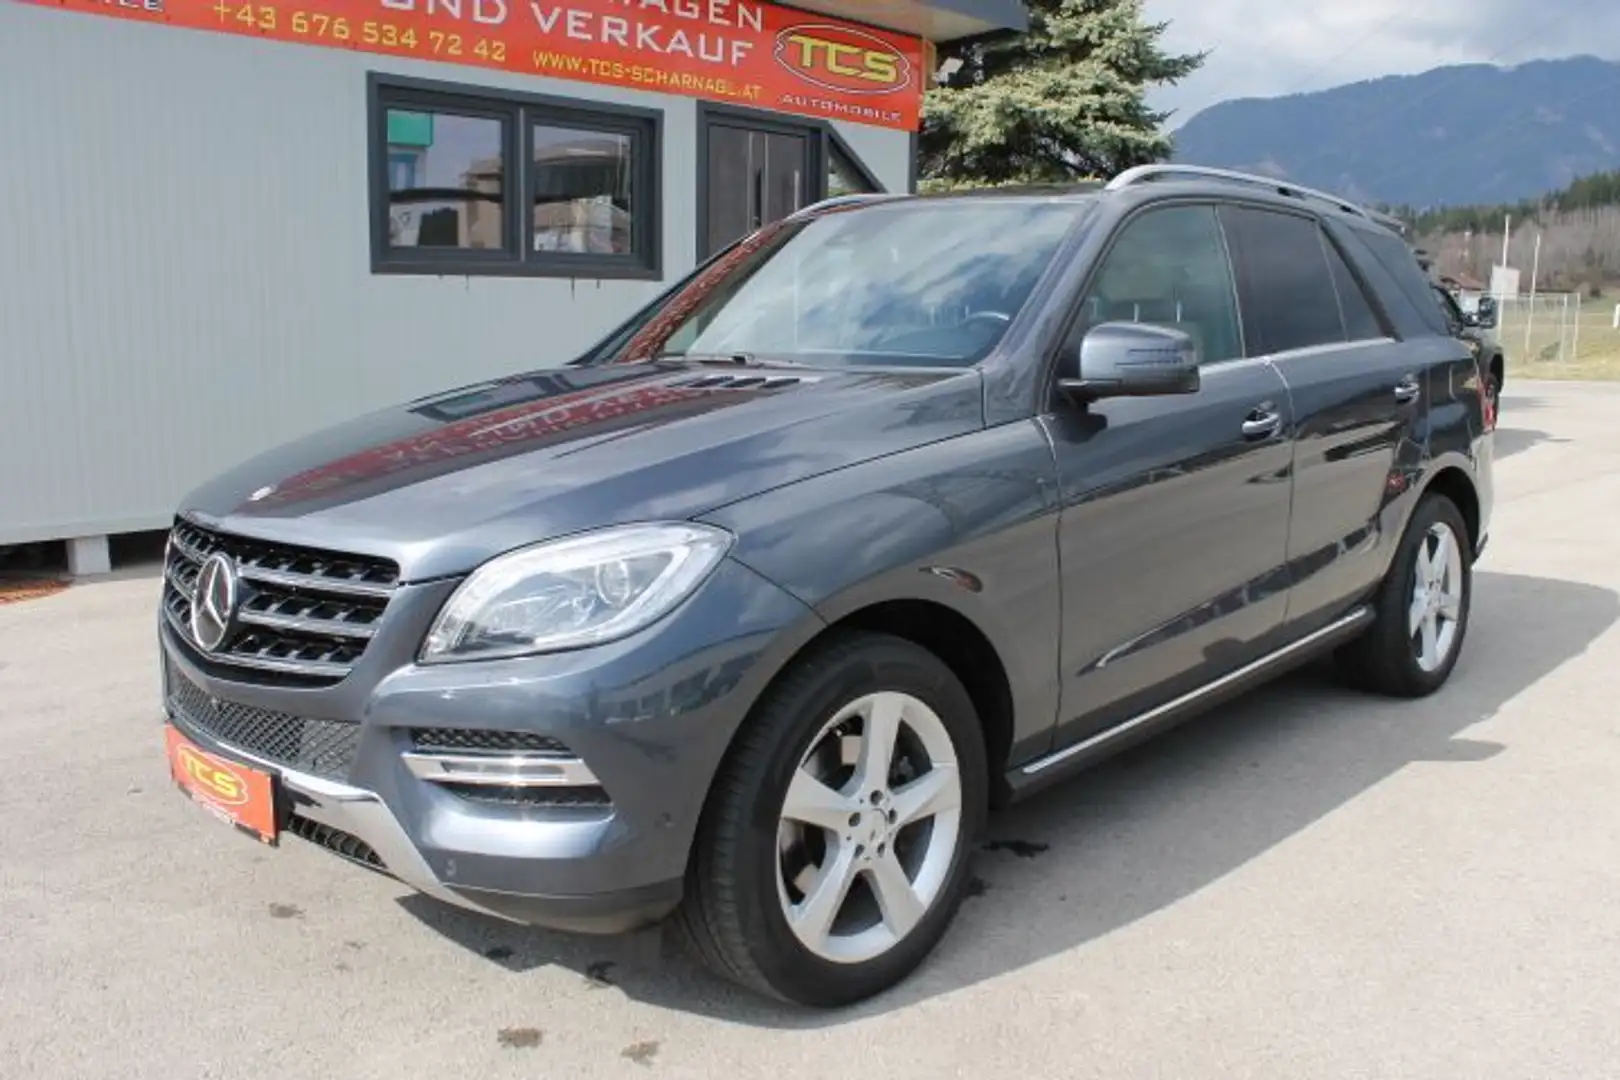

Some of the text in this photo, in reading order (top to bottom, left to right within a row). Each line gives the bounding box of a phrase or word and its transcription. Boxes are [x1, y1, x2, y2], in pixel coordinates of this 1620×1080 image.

[213, 0, 506, 62] +43 676 534 72 42
[529, 2, 753, 66] VERKAUF
[607, 0, 762, 32] AGEN
[787, 34, 899, 82] TCS
[779, 94, 901, 121] AUTOMOBILE
